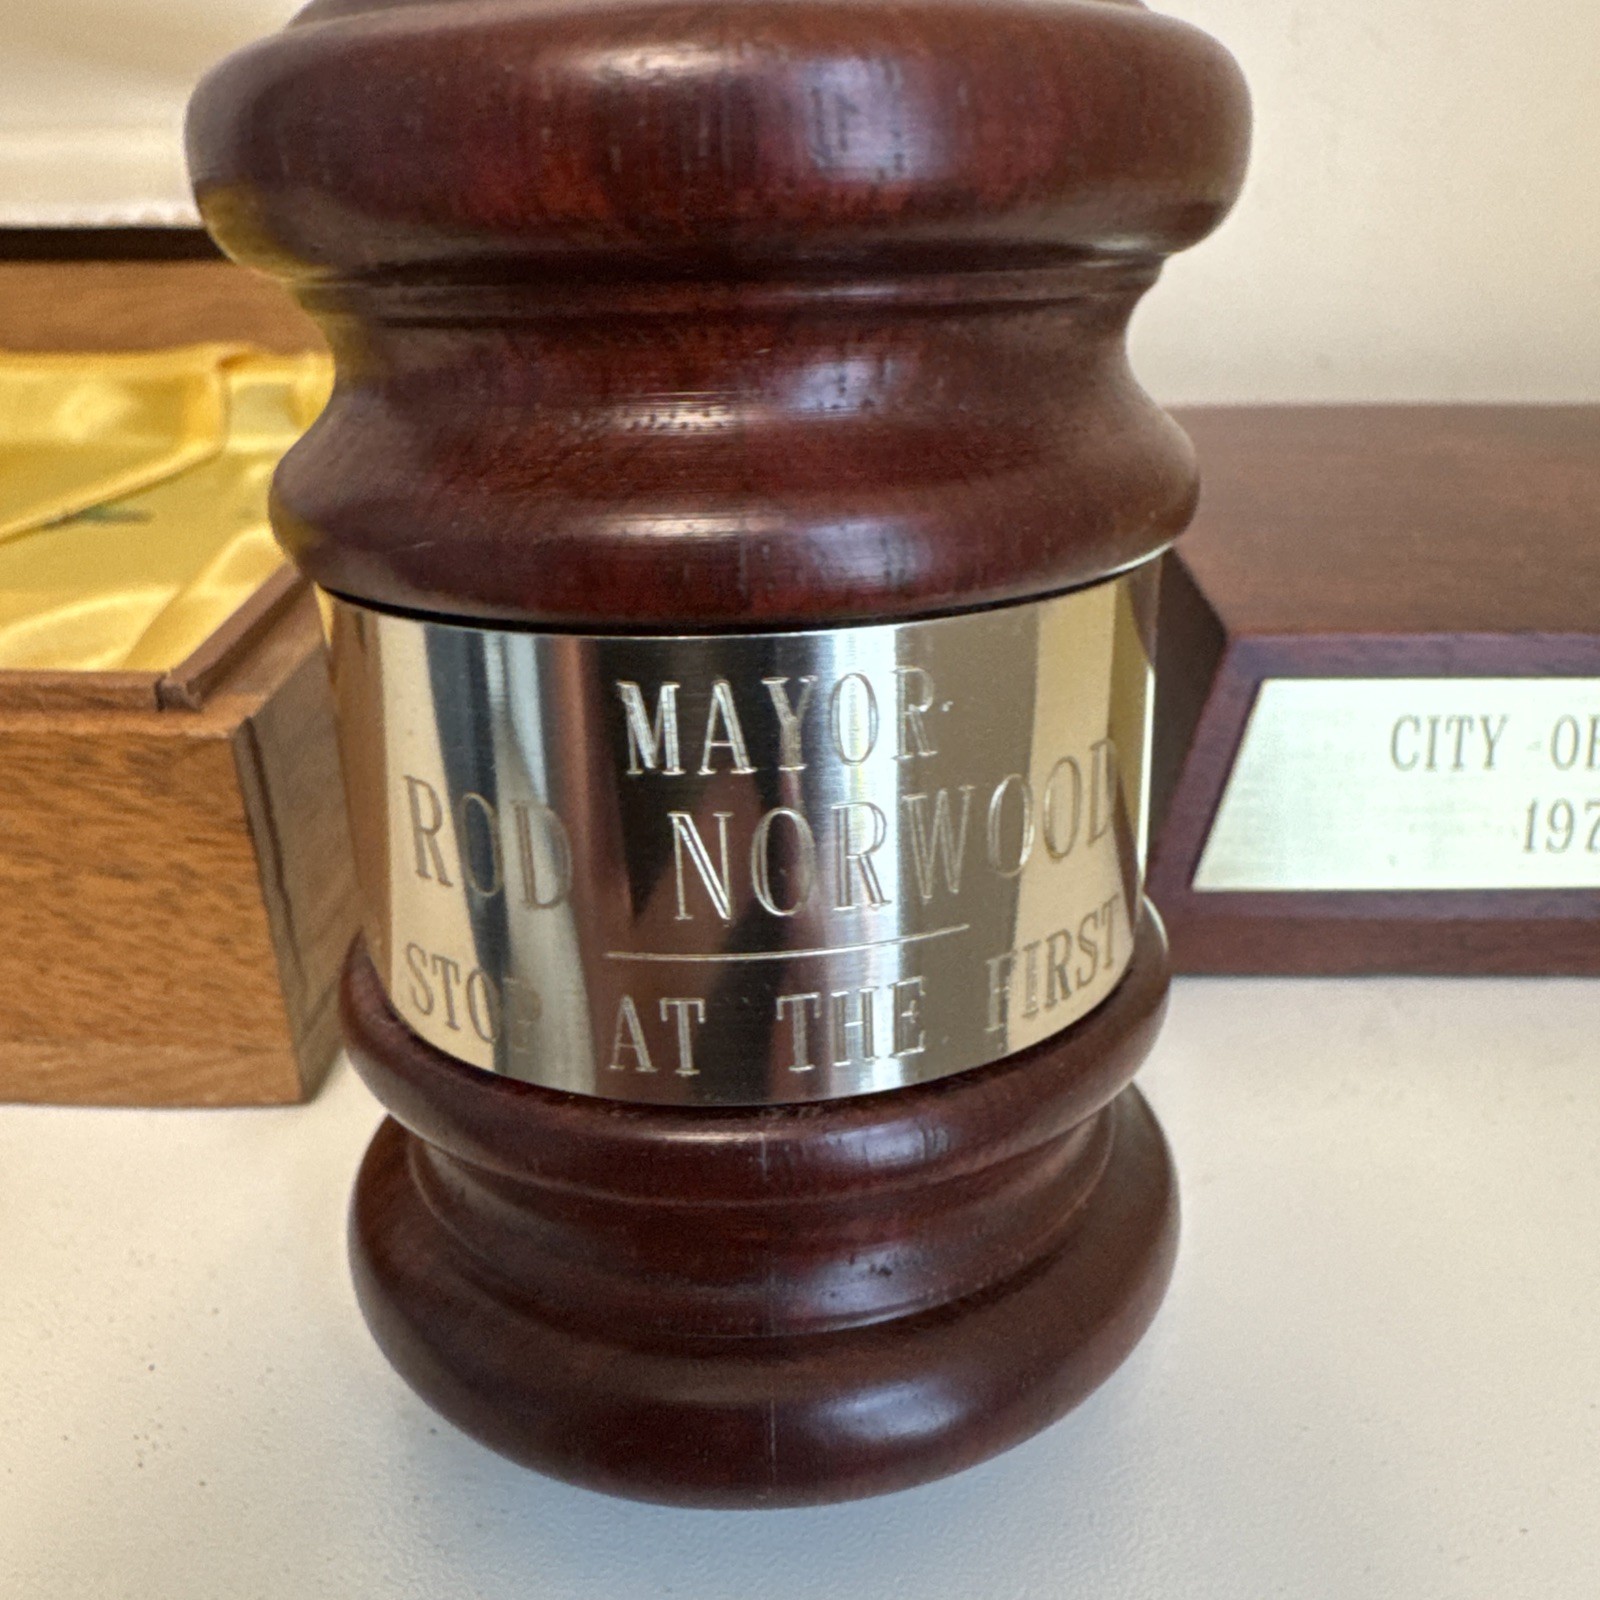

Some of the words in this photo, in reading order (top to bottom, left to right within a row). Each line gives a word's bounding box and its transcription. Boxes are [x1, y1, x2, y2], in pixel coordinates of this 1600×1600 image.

[616, 664, 939, 777] MAYOR
[1390, 713, 1509, 772] CITY
[402, 774, 572, 909] ROD
[667, 736, 1117, 922] NORWOOD
[608, 994, 704, 1077] AT
[777, 976, 926, 1073] THE
[985, 891, 1119, 1034] FIRST
